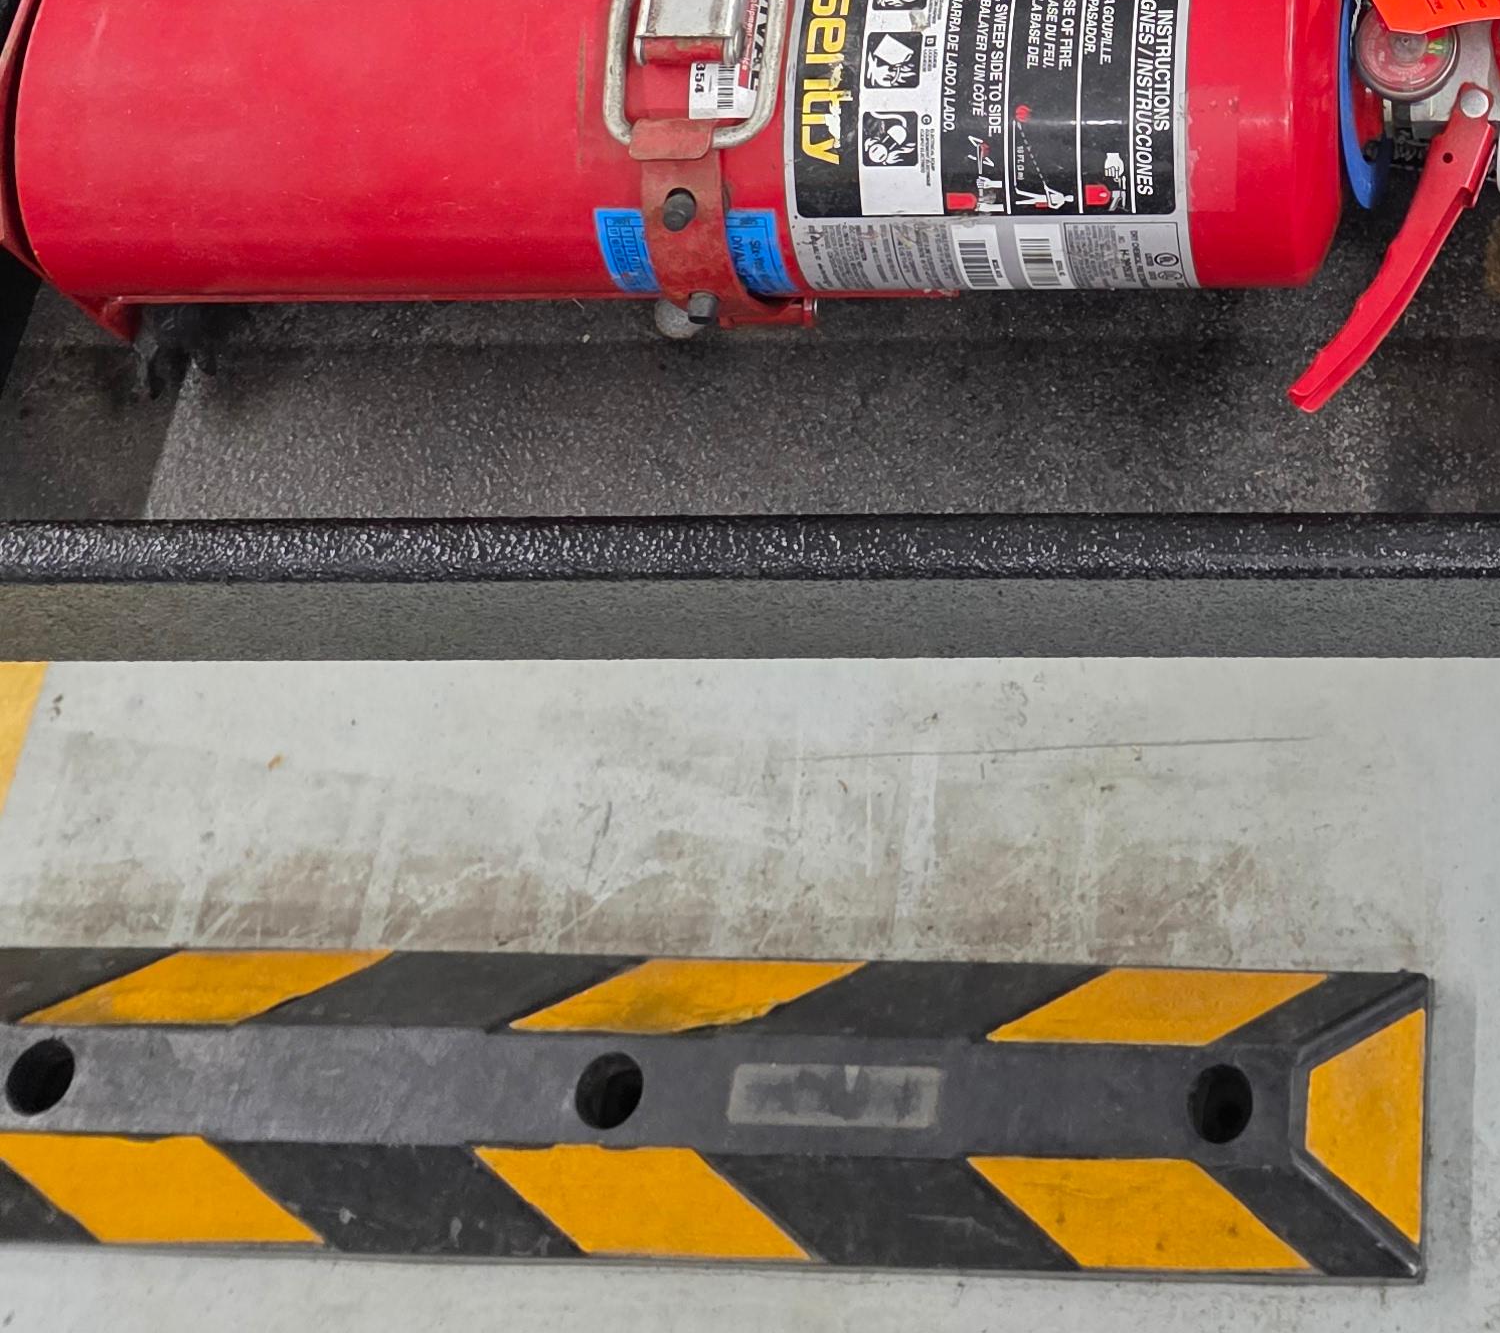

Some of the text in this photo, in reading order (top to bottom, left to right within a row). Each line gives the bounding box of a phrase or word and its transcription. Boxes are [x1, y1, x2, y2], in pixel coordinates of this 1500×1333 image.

[991, 3, 1009, 48] SWEEP
[1028, 13, 1042, 45] BASE
[1044, 24, 1056, 41] DU
[1061, 18, 1074, 36] OF
[947, 34, 959, 50] DE
[1042, 43, 1055, 69] FEU.
[1058, 38, 1073, 71] FIRE.
[1137, 47, 1154, 57] /
[945, 52, 958, 85] LADO
[973, 53, 987, 81] D'UN
[990, 51, 1004, 81] SIDE
[1026, 46, 1040, 69] DEL
[1154, 9, 1174, 131] INSTRUCTIONS
[944, 87, 956, 96] A
[972, 87, 987, 117] CÔTÉ
[988, 83, 1002, 101] TO
[943, 98, 955, 133] LADO.
[988, 104, 1002, 137] SIDE.
[1136, 58, 1153, 195] INSTRUCCIONES
